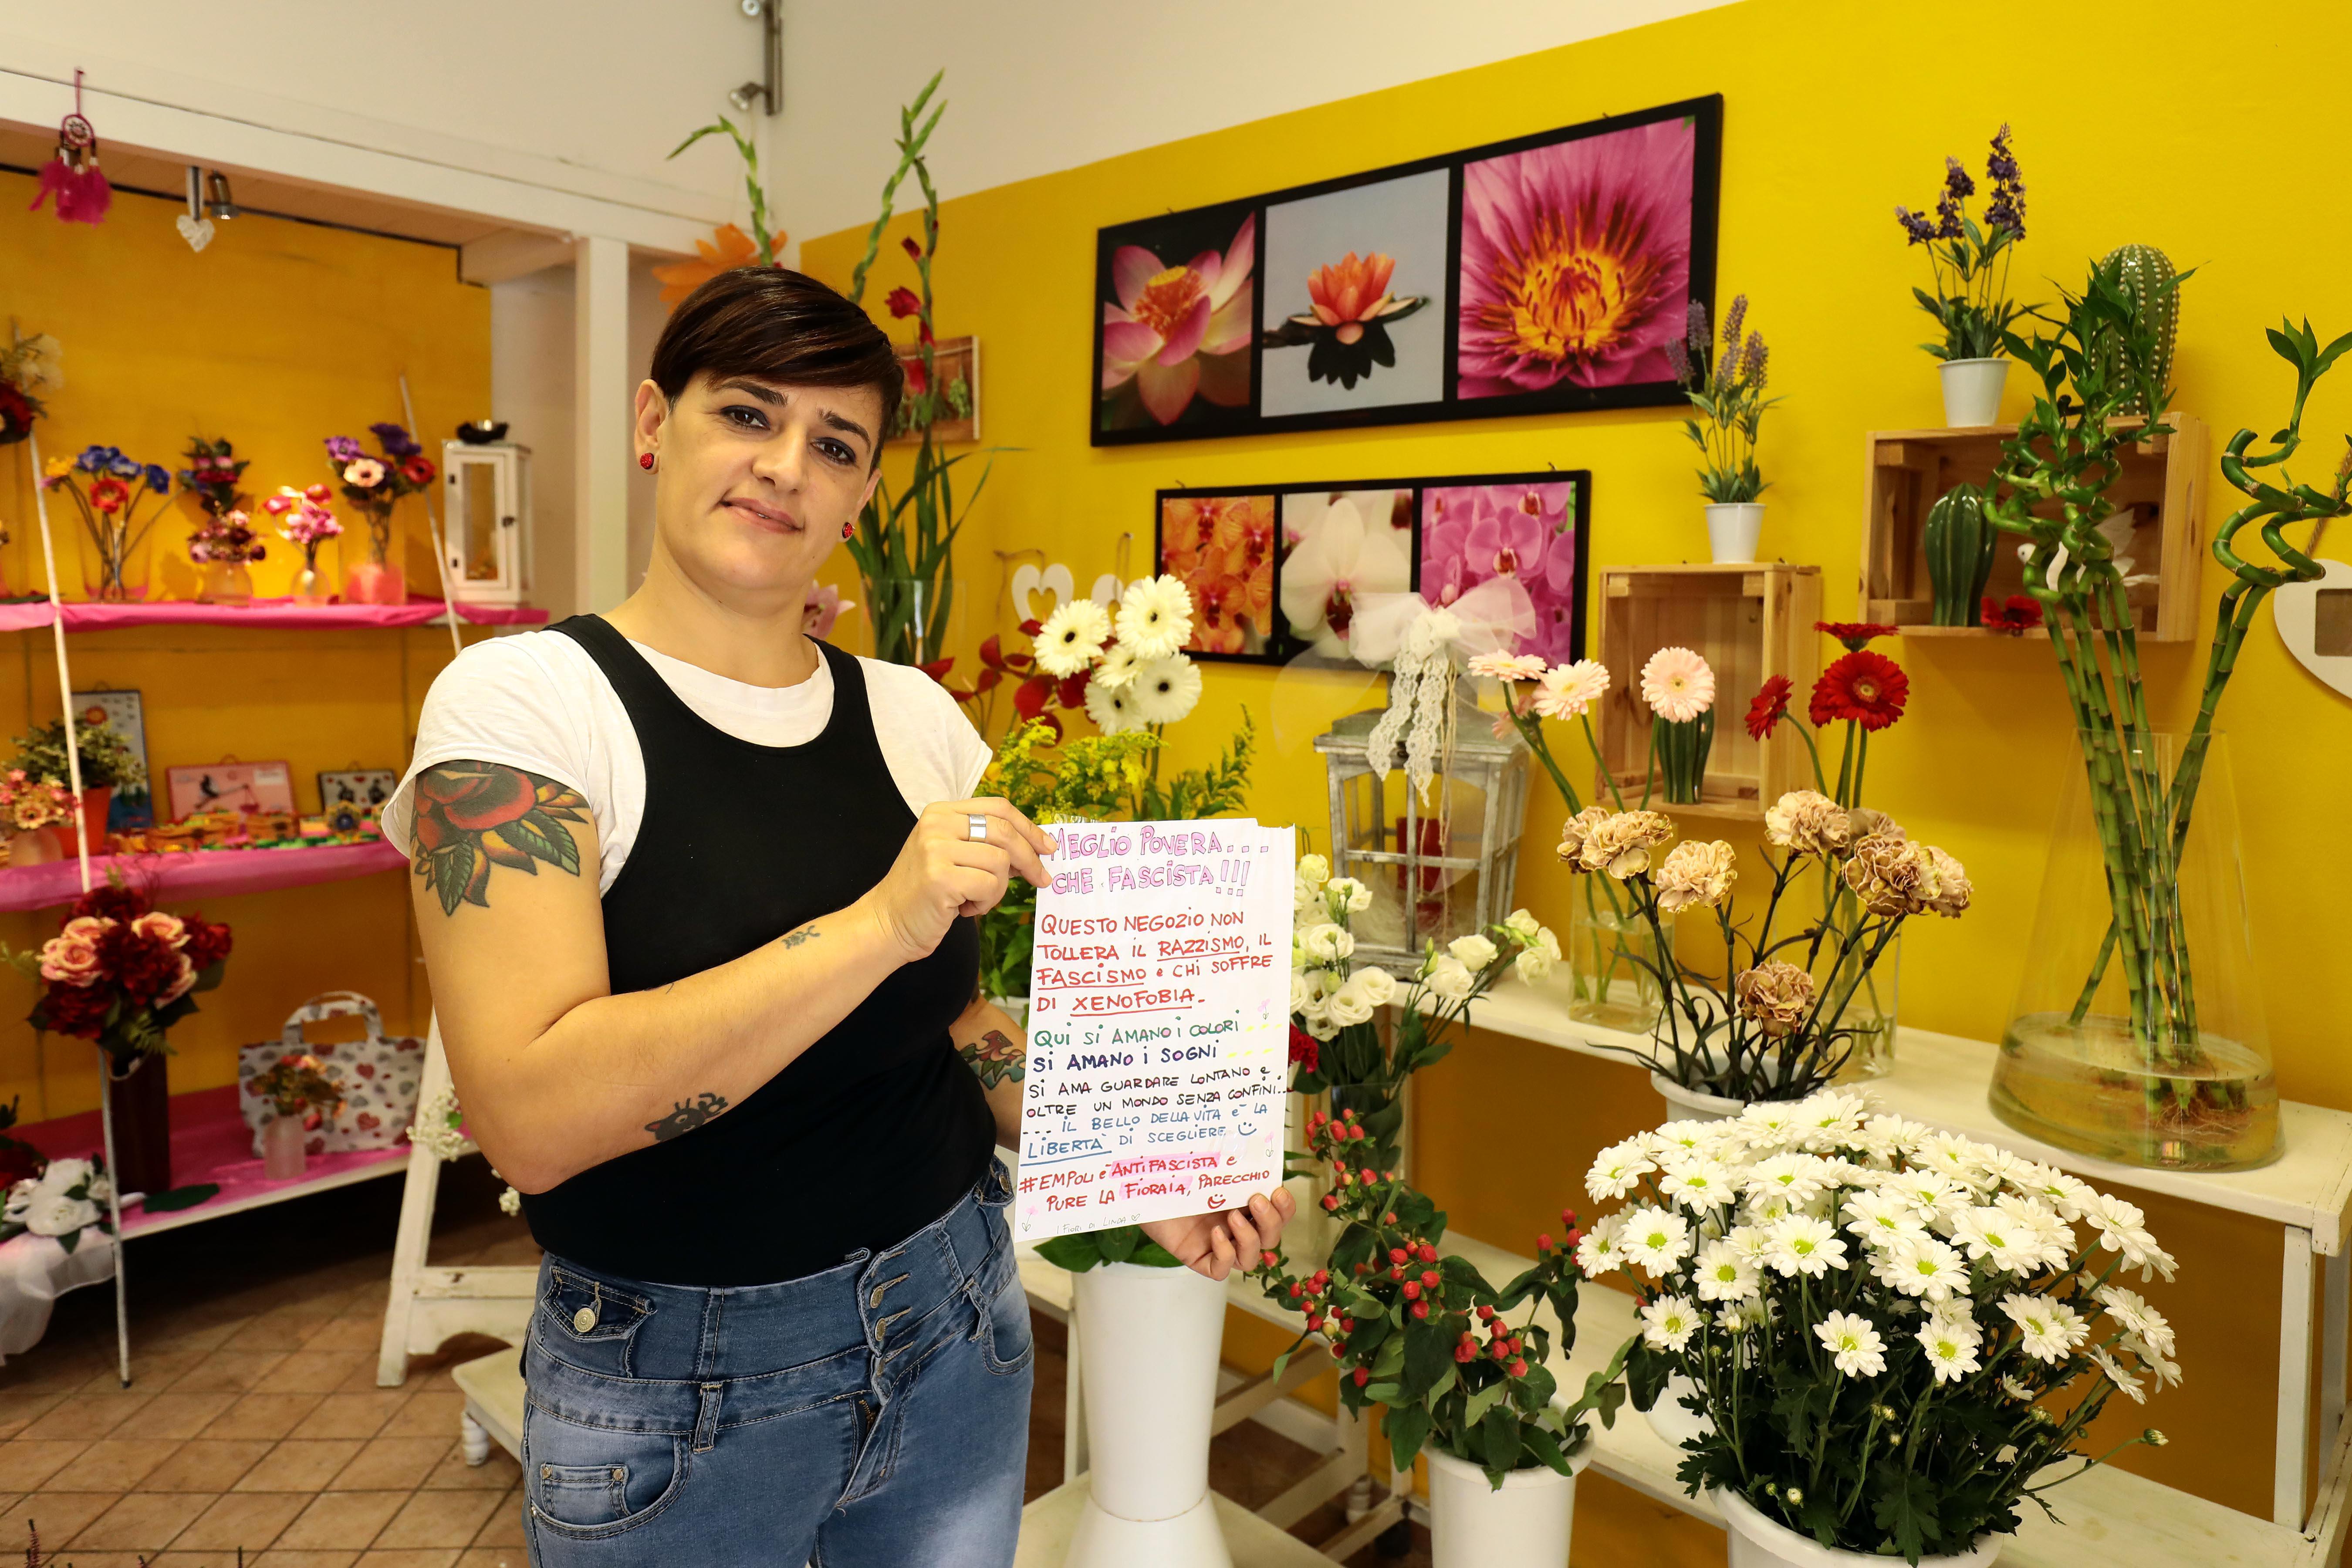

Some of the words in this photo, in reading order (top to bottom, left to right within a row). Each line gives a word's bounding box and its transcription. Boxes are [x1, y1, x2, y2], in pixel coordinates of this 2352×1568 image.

[1052, 868, 1093, 894] CHE
[1041, 914, 1117, 936] QUESTO
[1124, 907, 1204, 932] NEGOZIO
[1211, 911, 1244, 926] NON
[1037, 945, 1119, 960] TOLLERA
[1259, 933, 1272, 946] IL
[1036, 963, 1146, 987] FASCISMO
[1173, 959, 1200, 977] CHI
[1211, 955, 1273, 973] SOFFRE
[1037, 997, 1055, 1012] DI
[1034, 1022, 1072, 1048] QUI
[1112, 1027, 1172, 1044] AMANO
[1067, 1052, 1133, 1071] AMANO
[1058, 1082, 1092, 1095] AMA
[1101, 1077, 1179, 1092] GUARDARE
[1190, 1067, 1250, 1085] LONTANO
[1027, 1105, 1077, 1118] OLTRE
[1094, 1101, 1112, 1112] UN
[1122, 1096, 1168, 1109] MONDO
[1177, 1092, 1220, 1105] SENZA
[1092, 1116, 1140, 1130] BELLO
[1151, 1112, 1190, 1123] DELLA
[1194, 1104, 1221, 1121] VITA
[1254, 1103, 1268, 1114] LA
[1119, 1127, 1134, 1145] DI
[1019, 1171, 1094, 1193] #EMPOLI
[1112, 1151, 1219, 1177] ANTIFASCISTA
[1046, 1195, 1087, 1212] PURE
[1099, 1190, 1115, 1204] LA
[1198, 1170, 1270, 1190] PARECCHIO
[1063, 1223, 1081, 1233] FIORI
[1103, 1217, 1126, 1226] LINDA
